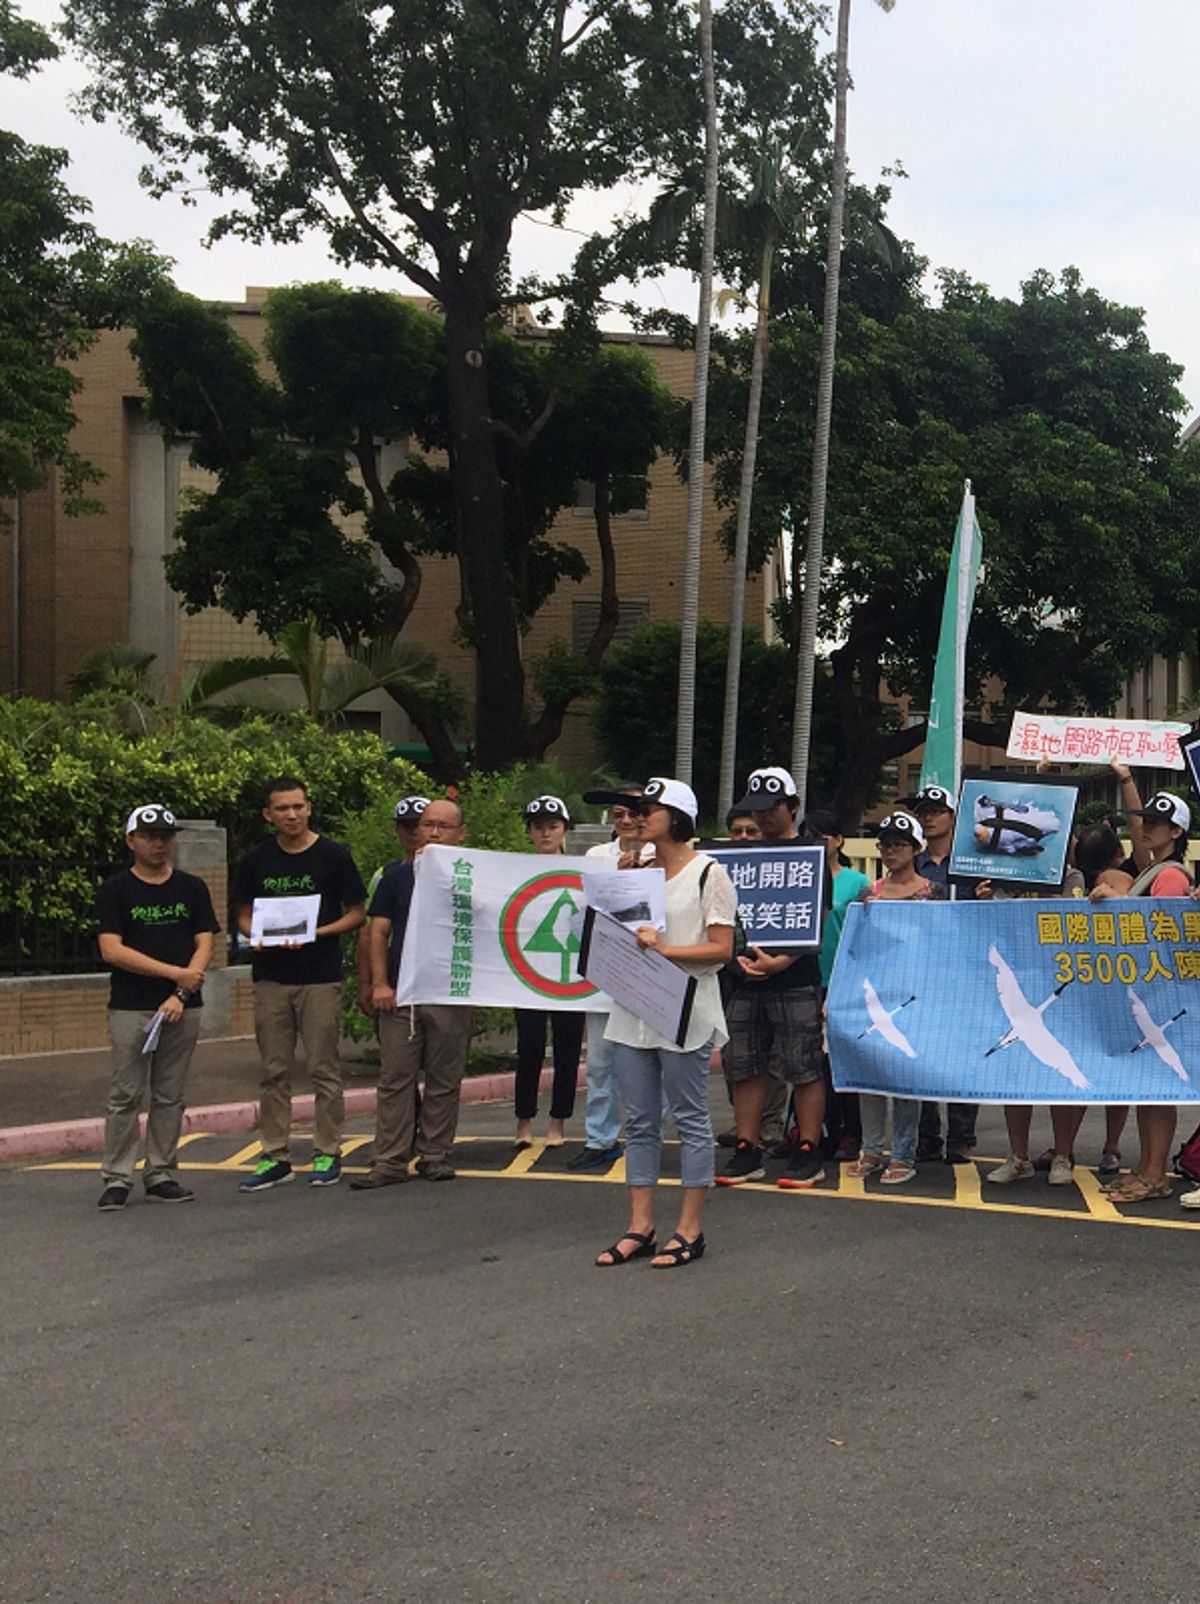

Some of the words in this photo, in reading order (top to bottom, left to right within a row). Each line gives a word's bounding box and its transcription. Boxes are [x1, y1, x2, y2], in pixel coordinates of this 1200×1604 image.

[720, 861, 815, 889] 地開路
[450, 857, 475, 997] 台灣環境保護聯盟
[737, 901, 813, 930] 際笑話
